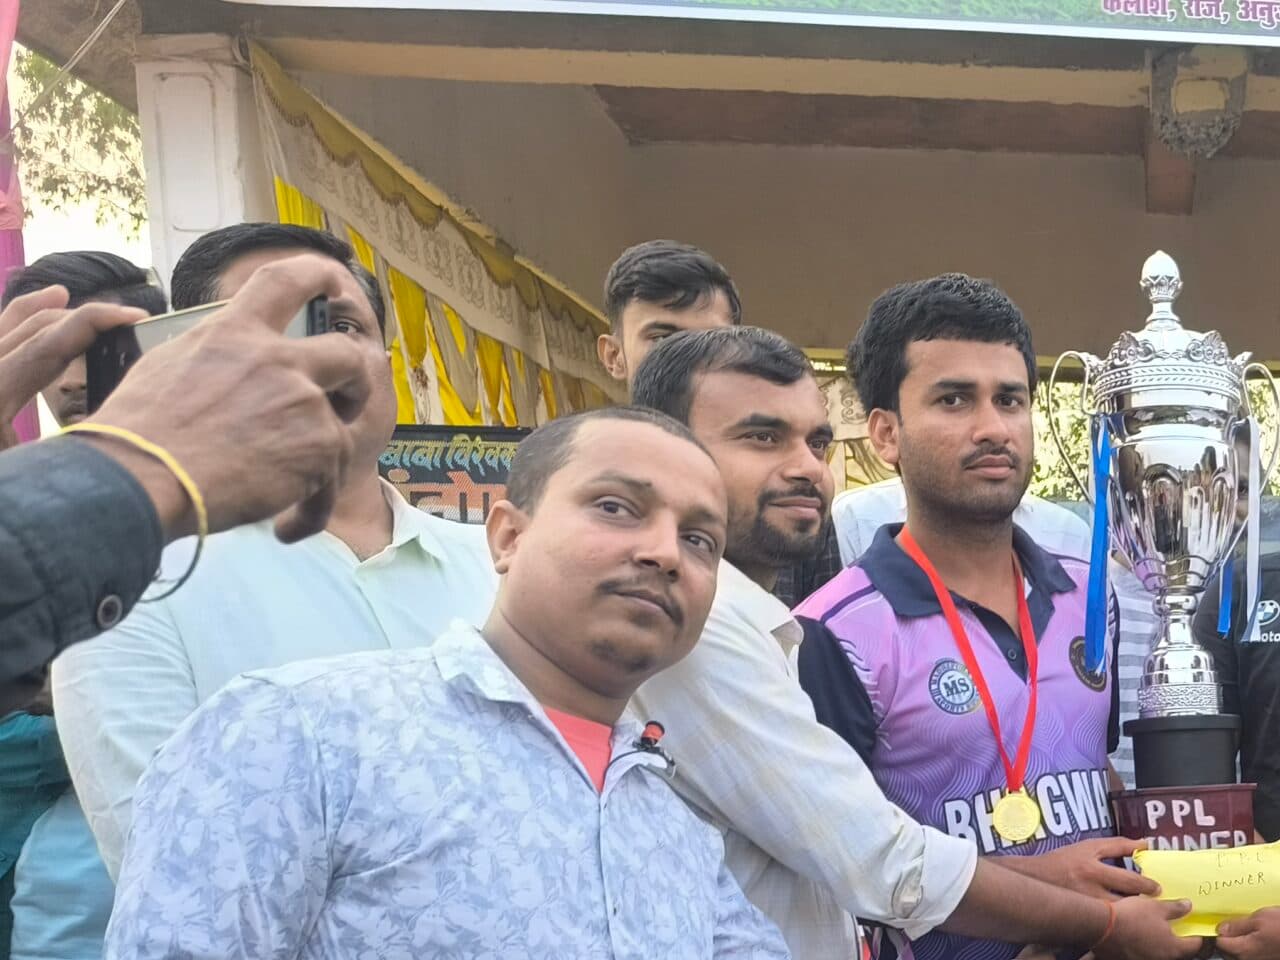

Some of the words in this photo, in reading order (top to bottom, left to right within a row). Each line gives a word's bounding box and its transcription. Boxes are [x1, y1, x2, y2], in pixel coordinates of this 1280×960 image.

[943, 677, 970, 697] MS
[1145, 798, 1216, 829] PPL
[1198, 871, 1266, 895] WINNER
